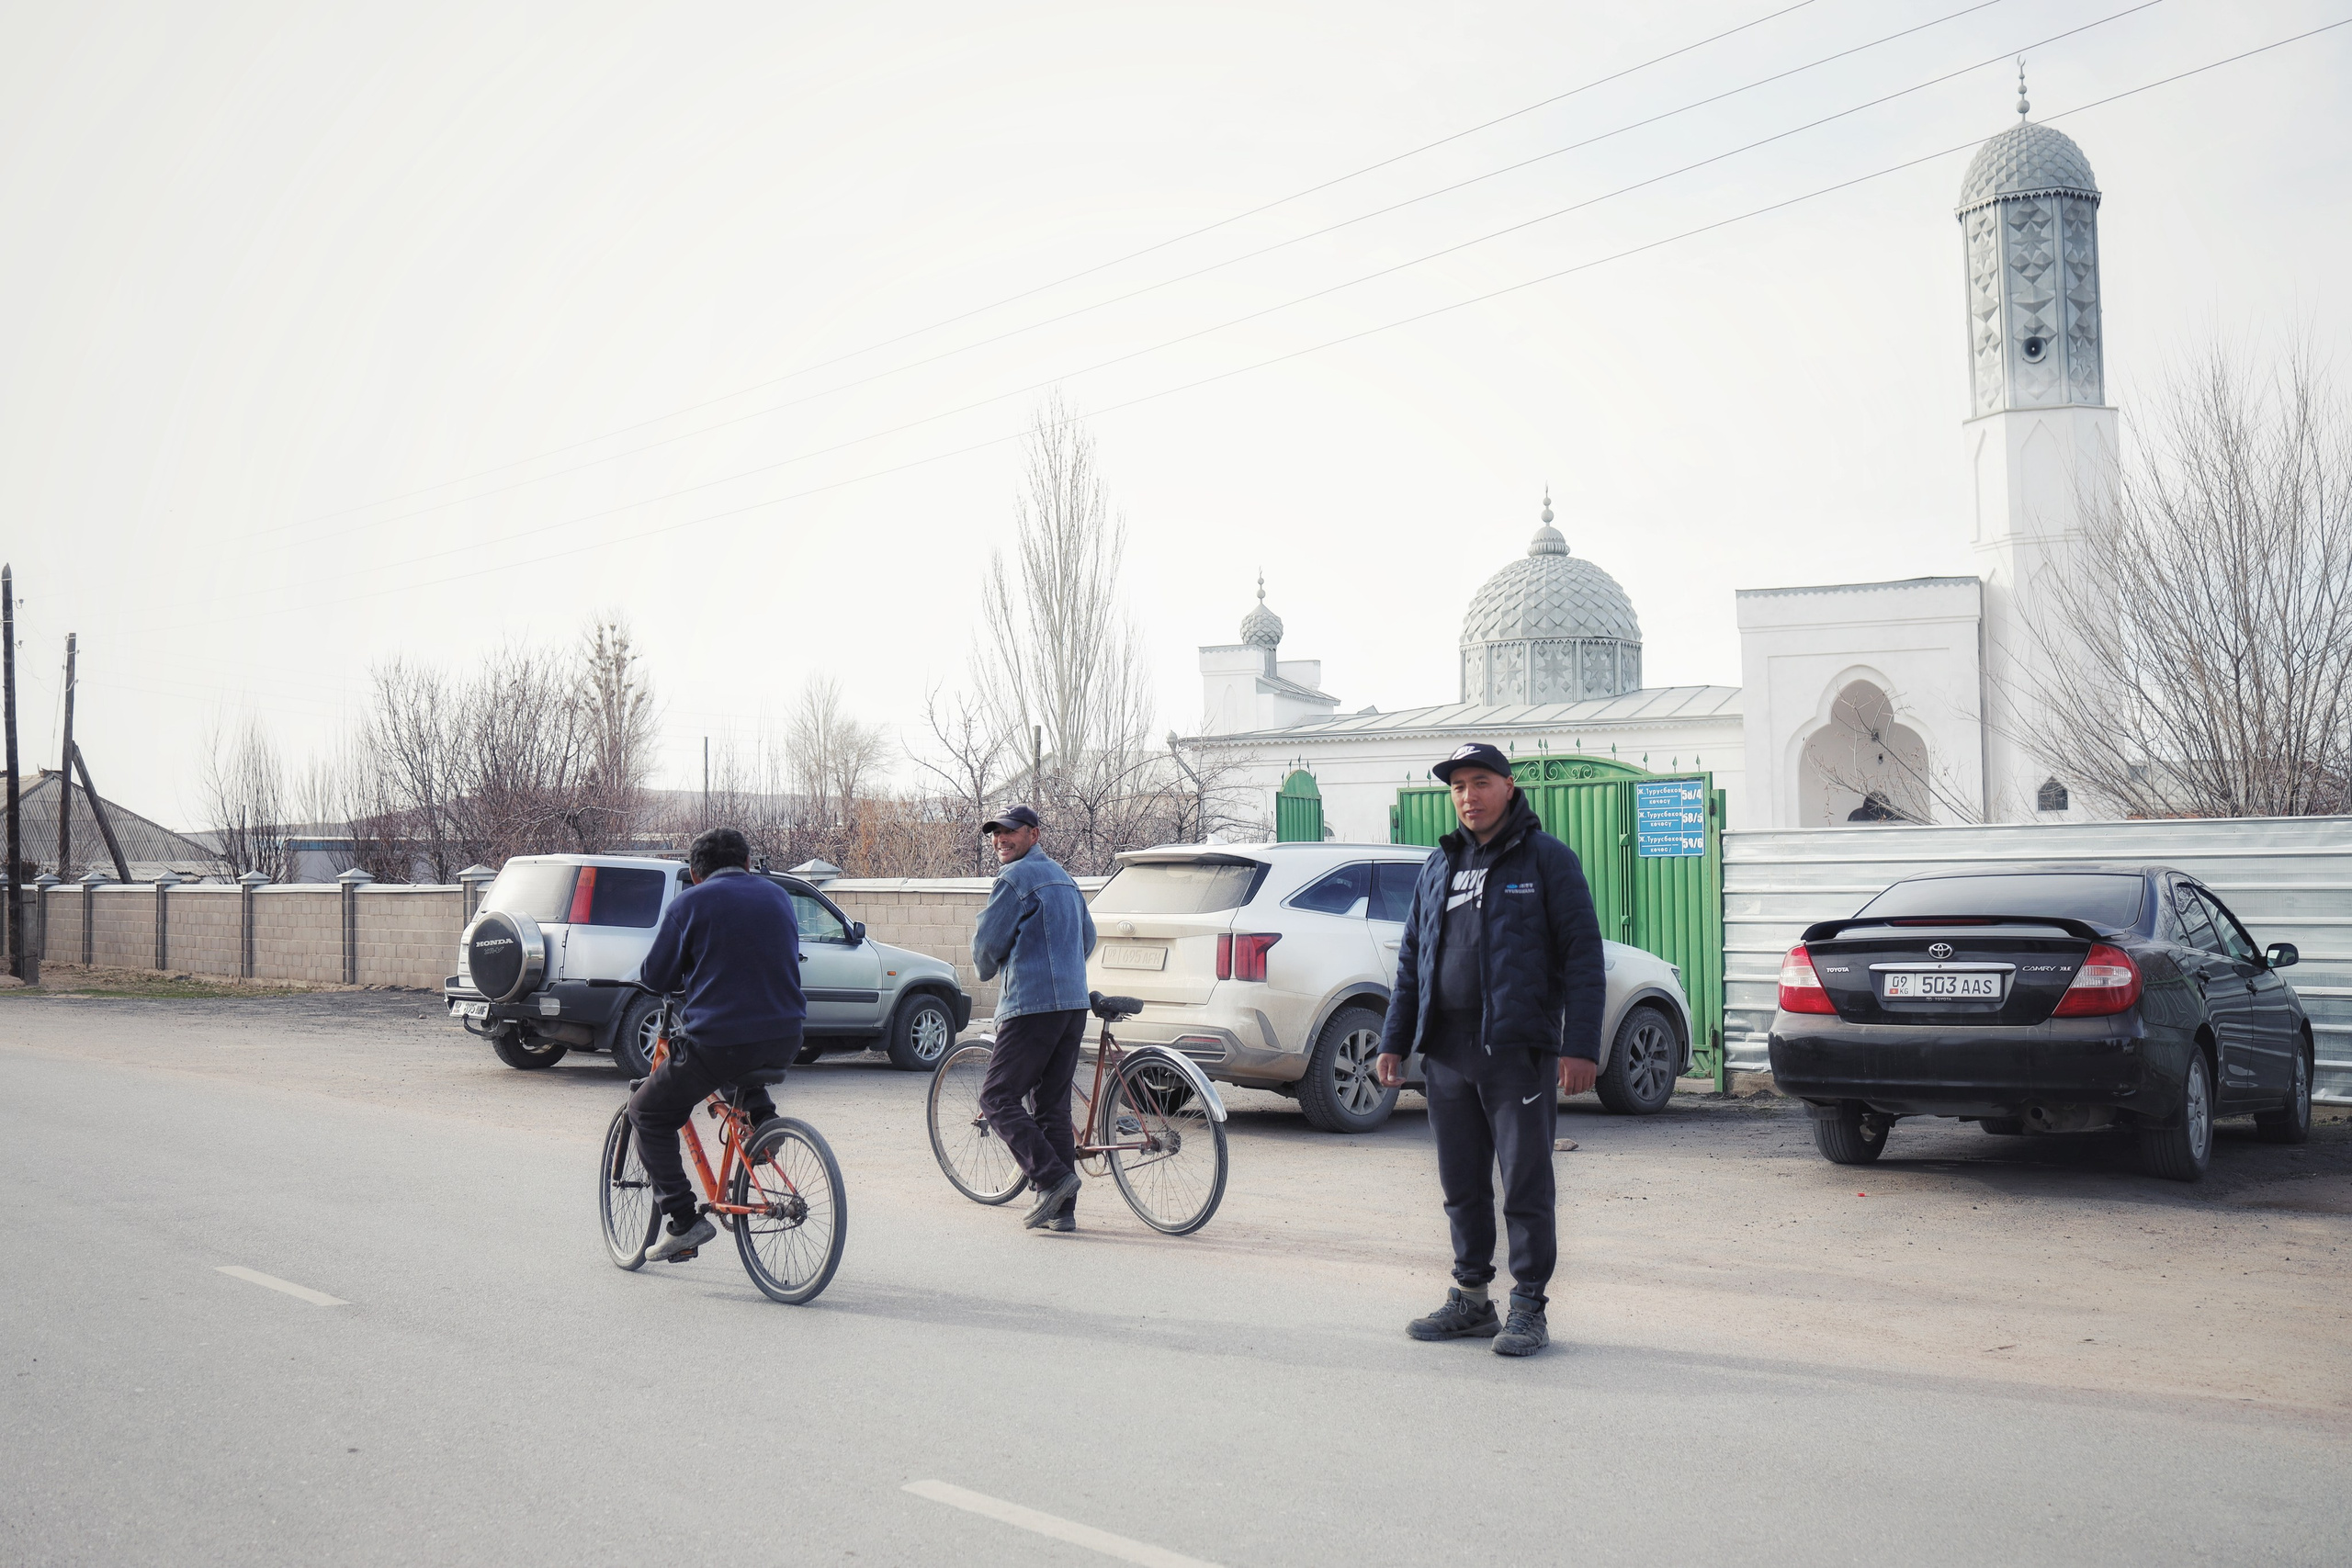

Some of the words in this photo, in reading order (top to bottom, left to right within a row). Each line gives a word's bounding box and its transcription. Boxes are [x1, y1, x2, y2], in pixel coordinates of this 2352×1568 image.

[1452, 745, 1476, 761] NIKE
[1682, 789, 1702, 800] 58/4
[1683, 812, 1702, 823] 58/5
[1683, 838, 1702, 849] 58/6
[1451, 868, 1488, 891] NIK
[476, 938, 514, 947] HONDA
[1123, 948, 1142, 963] 695
[1893, 976, 1907, 987] 09
[1922, 976, 1957, 994] 503
[1961, 979, 1993, 995] AAS
